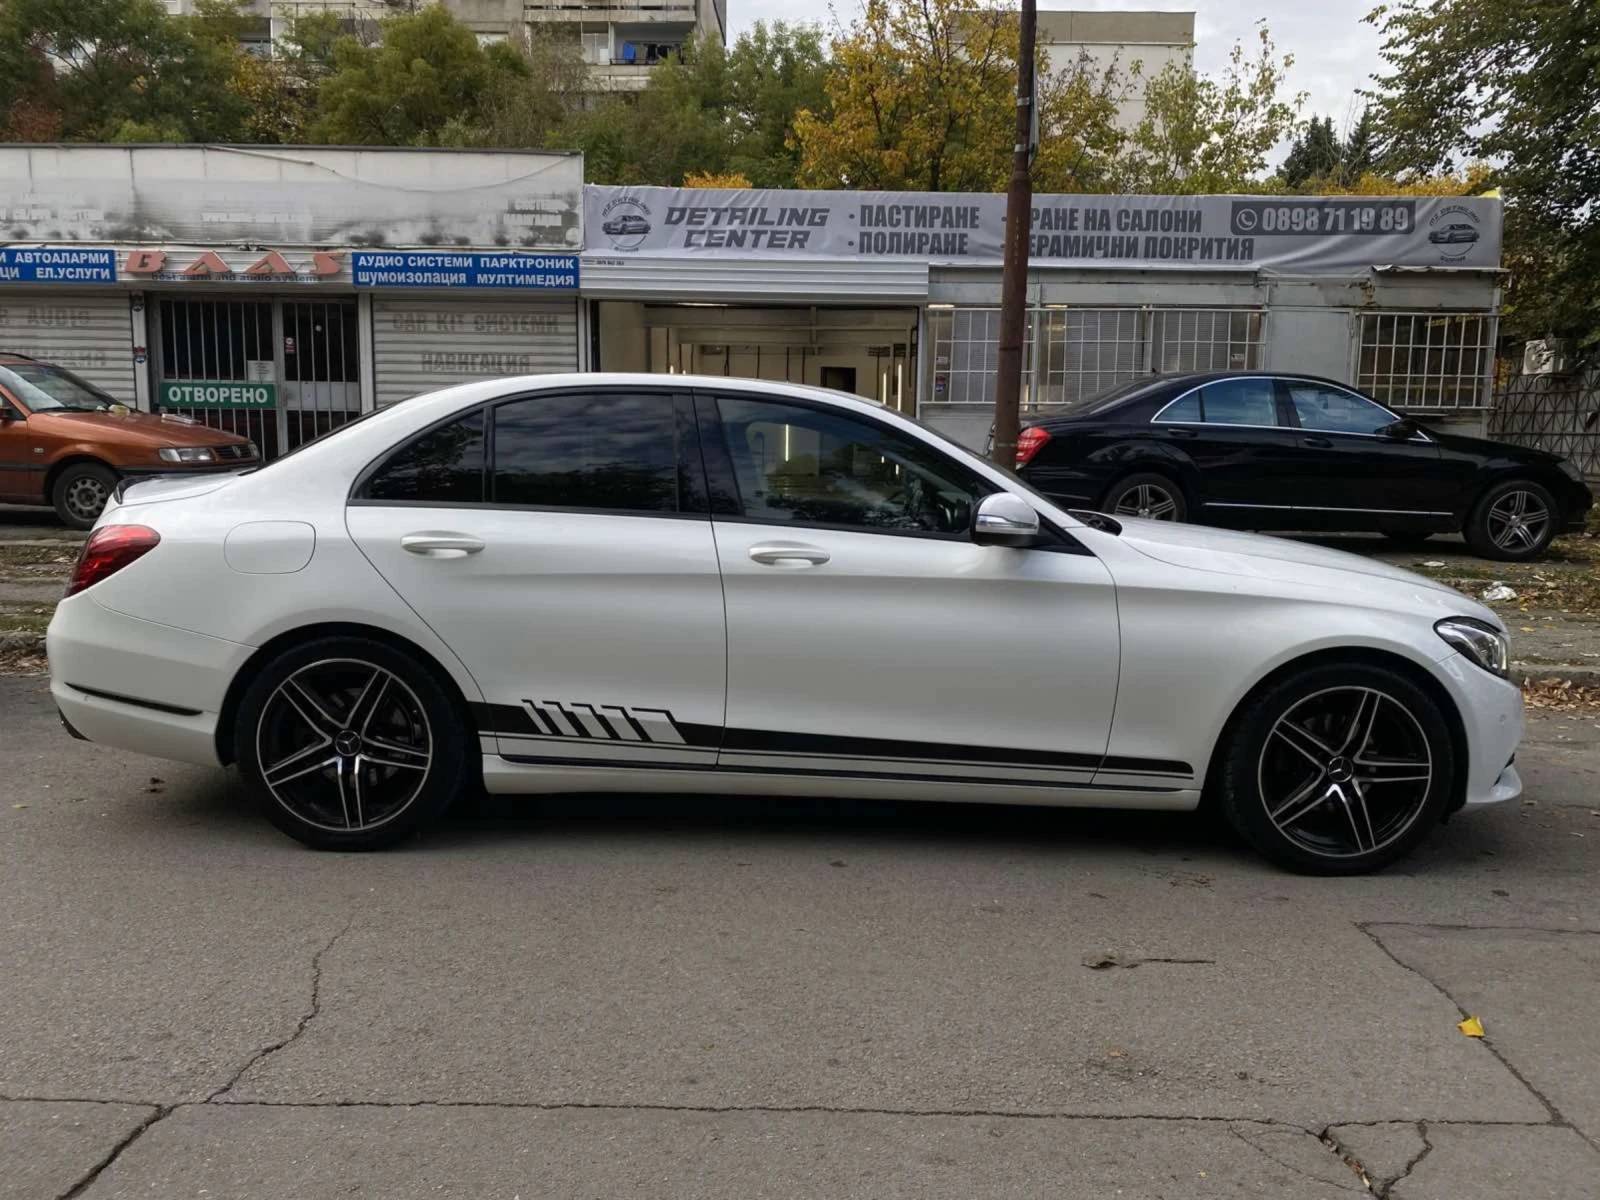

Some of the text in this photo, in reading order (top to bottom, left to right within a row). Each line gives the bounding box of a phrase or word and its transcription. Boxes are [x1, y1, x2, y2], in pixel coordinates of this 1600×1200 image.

[664, 207, 830, 227] DETAILING
[860, 204, 980, 229] ПАСТИРАНЕ
[1030, 207, 1203, 233] РАНЕ НА САЛОНИ
[1261, 206, 1409, 232] 0898 71 19 89
[683, 229, 811, 249] CENTER
[859, 231, 969, 256] ПОЛИРАНЕ
[1028, 233, 1139, 259] ЕРАМИЧНИ
[1143, 236, 1254, 261] ПОКРИТИЯ
[15, 252, 109, 264] АВТОАЛАРМИ
[124, 251, 346, 276] BAAS
[358, 256, 404, 269] АУДИО
[407, 257, 473, 268] СИСТЕМИ
[480, 258, 574, 269] ПАРКТРОНИК
[36, 267, 111, 280] ЕЛ.УСЛУГИ
[477, 274, 575, 287] МУЛТИМЕДИЯ
[168, 386, 268, 403] ОТВОРЕНО
